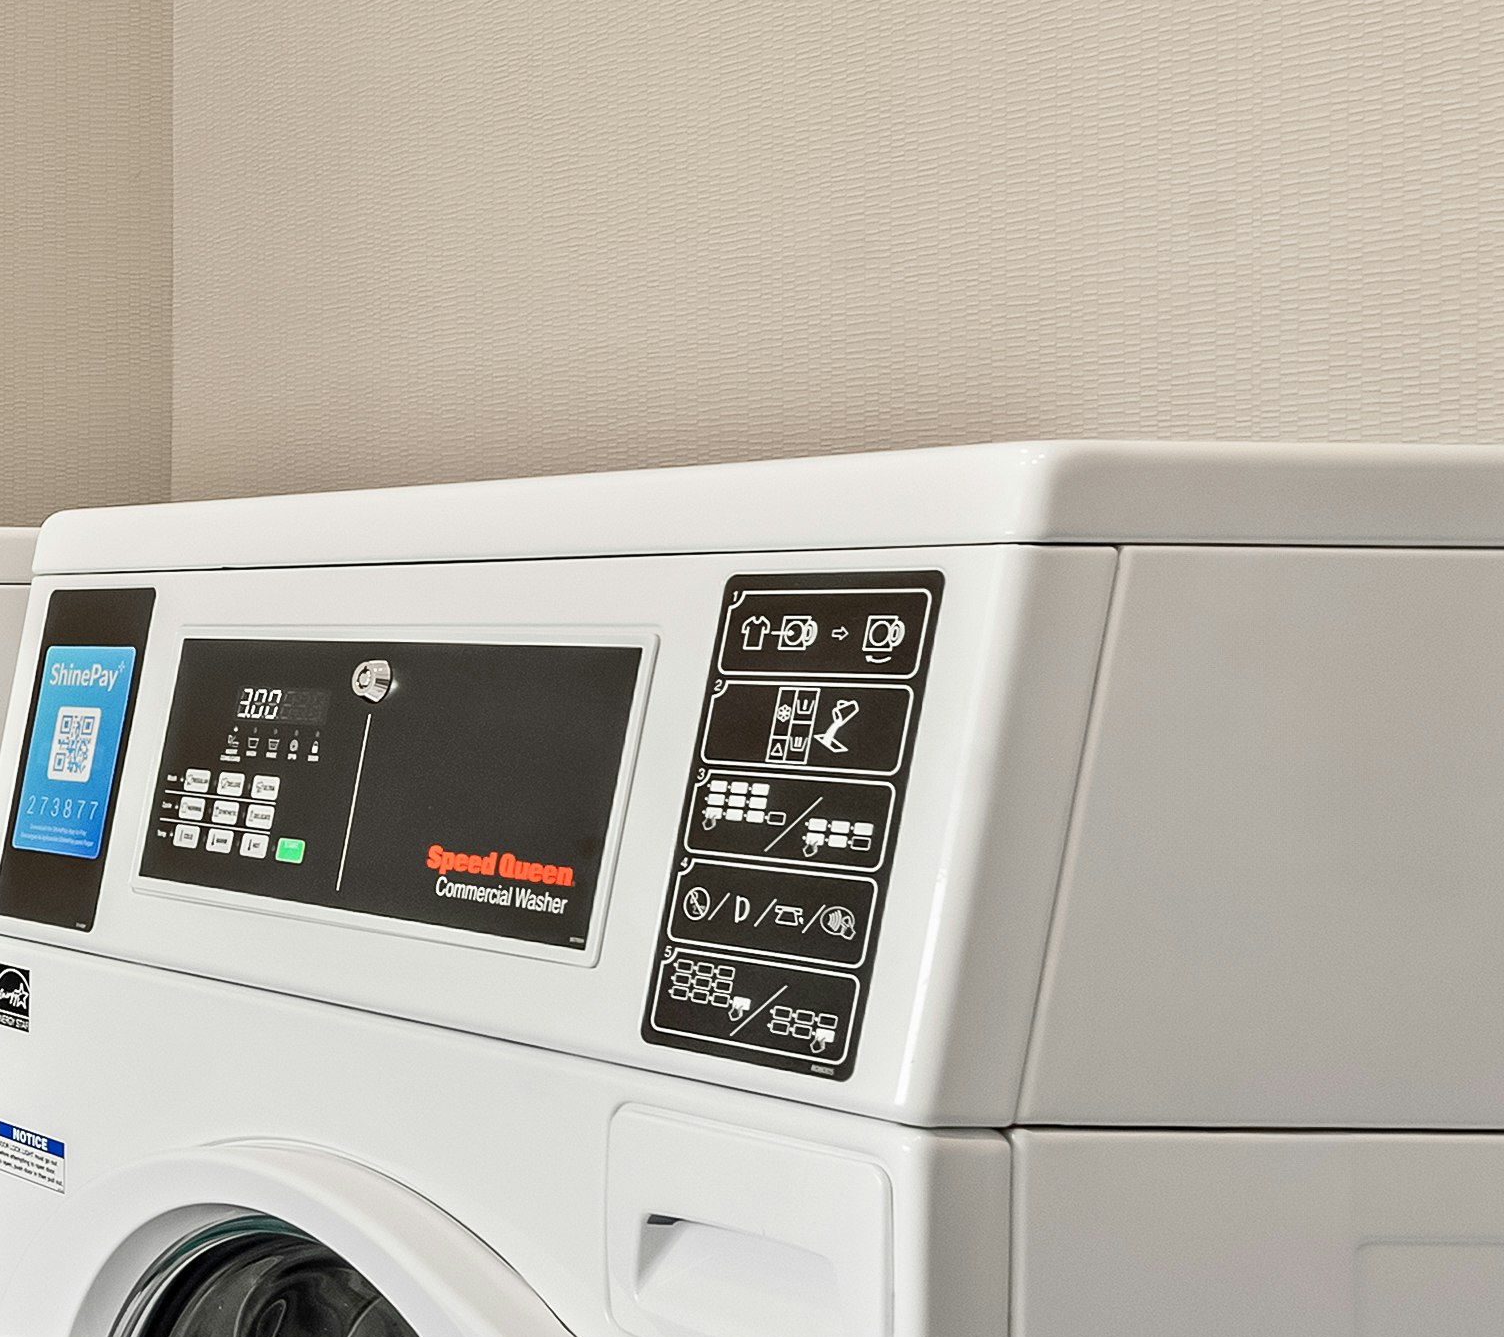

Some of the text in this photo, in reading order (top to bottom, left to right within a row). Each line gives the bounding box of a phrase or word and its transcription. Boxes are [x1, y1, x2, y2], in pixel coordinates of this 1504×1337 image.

[732, 590, 739, 602] 1
[49, 662, 118, 692] ShinePay
[713, 678, 723, 692] 2
[696, 767, 706, 781] 3
[26, 794, 99, 821] 273877
[426, 844, 574, 887] Speed Queen
[435, 875, 569, 914] Commercial Washer
[663, 945, 673, 958] 5
[12, 1127, 48, 1151] NOTICE
